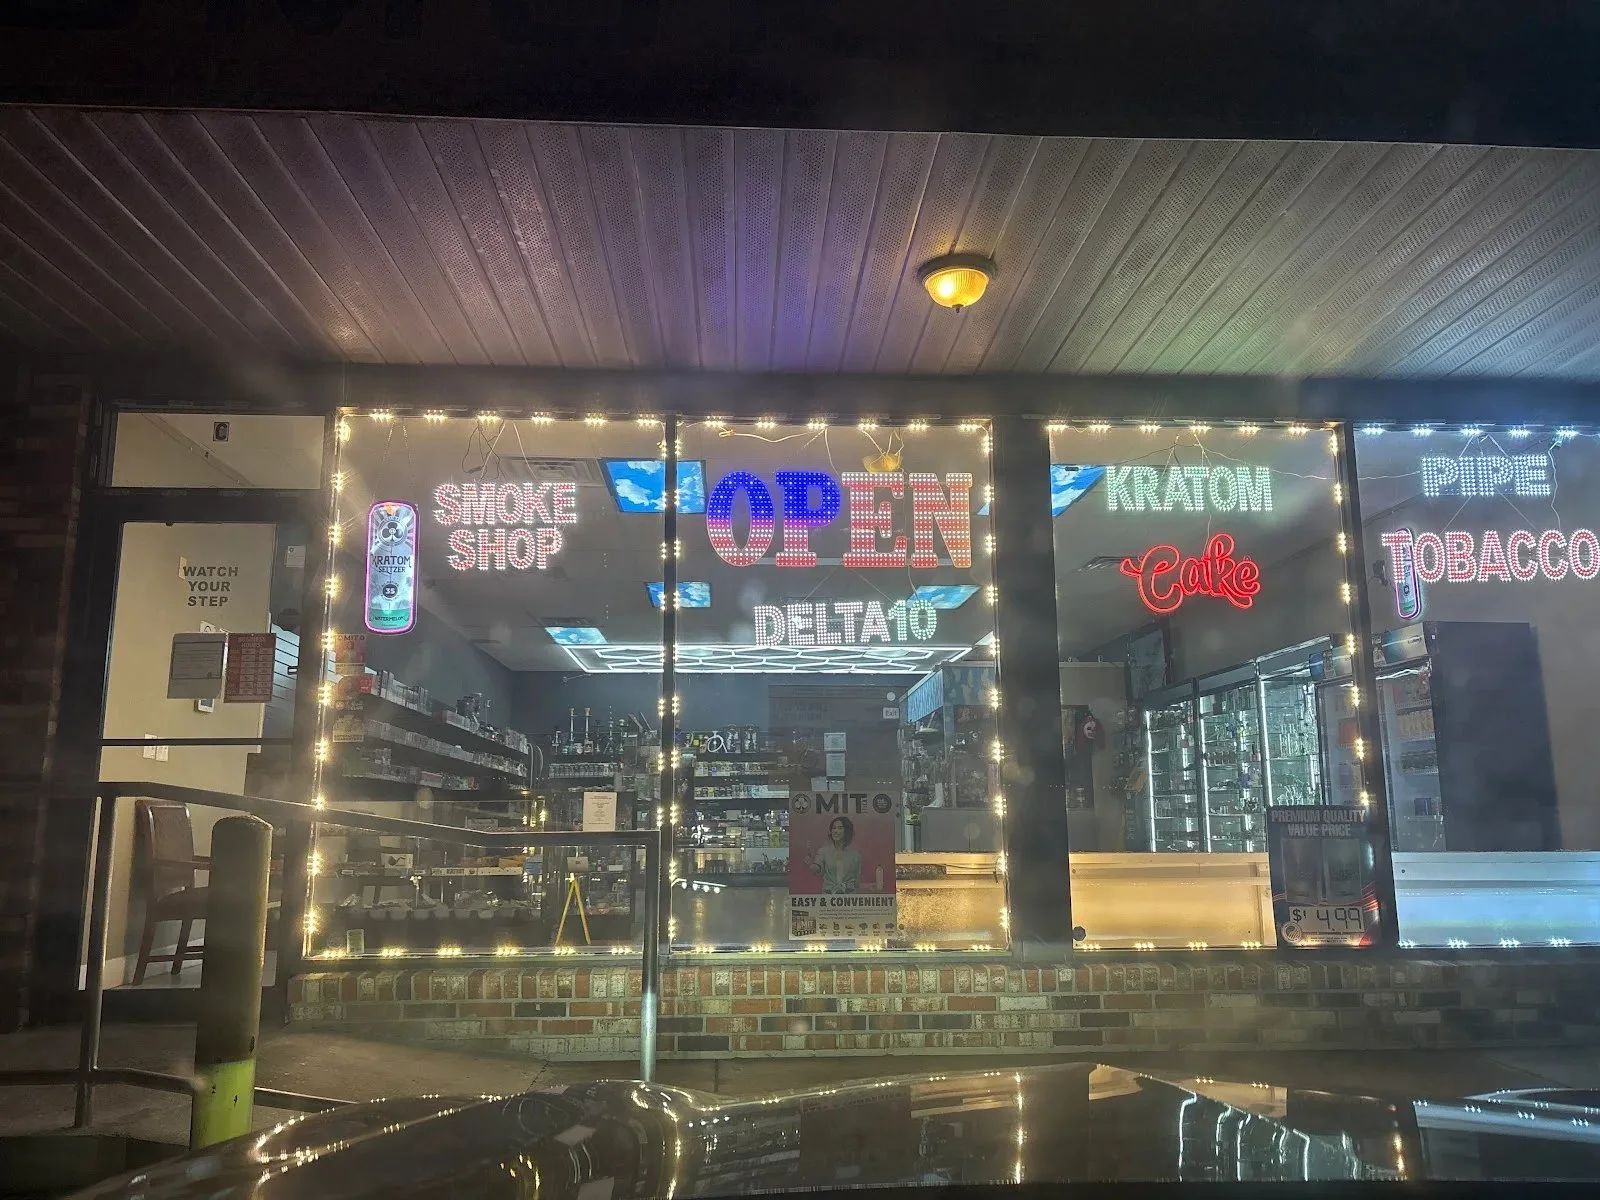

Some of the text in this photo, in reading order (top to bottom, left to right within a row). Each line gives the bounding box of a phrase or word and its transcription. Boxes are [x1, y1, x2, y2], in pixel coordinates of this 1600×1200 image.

[1105, 465, 1273, 512] KRATOM
[1421, 455, 1551, 497] PIPE
[432, 482, 577, 526] SMOKE
[706, 471, 973, 568] OPEN
[446, 527, 563, 571] SHOP
[1381, 528, 1600, 584] TOBACCO
[183, 566, 239, 577] WATCH
[187, 580, 231, 592] YOUR
[1119, 532, 1261, 613] Cake
[187, 595, 229, 607] STEP
[1271, 809, 1366, 824] PREMIUM QUALITY
[1287, 823, 1351, 837] VALUE PRICE
[791, 896, 894, 907] EASY & CONVENIENT
